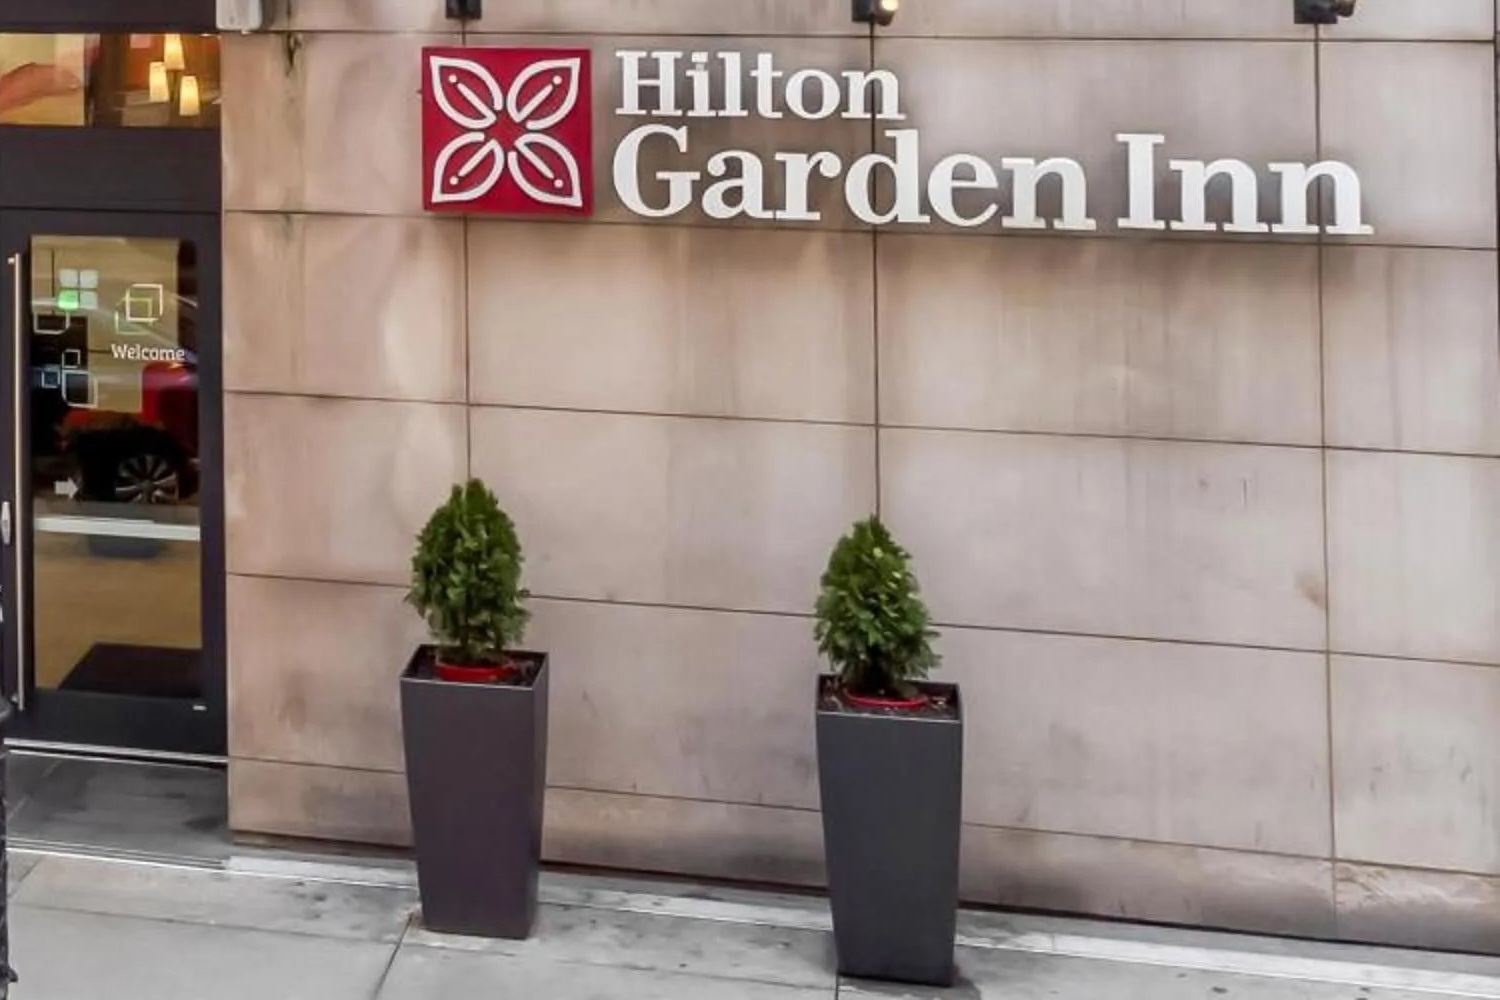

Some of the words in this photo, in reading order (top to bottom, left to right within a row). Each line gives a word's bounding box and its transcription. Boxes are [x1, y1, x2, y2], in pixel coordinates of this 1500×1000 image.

[614, 50, 905, 120] Hilton
[612, 123, 1097, 231] Garden
[1115, 132, 1374, 235] Inn
[110, 342, 186, 362] Welcome
